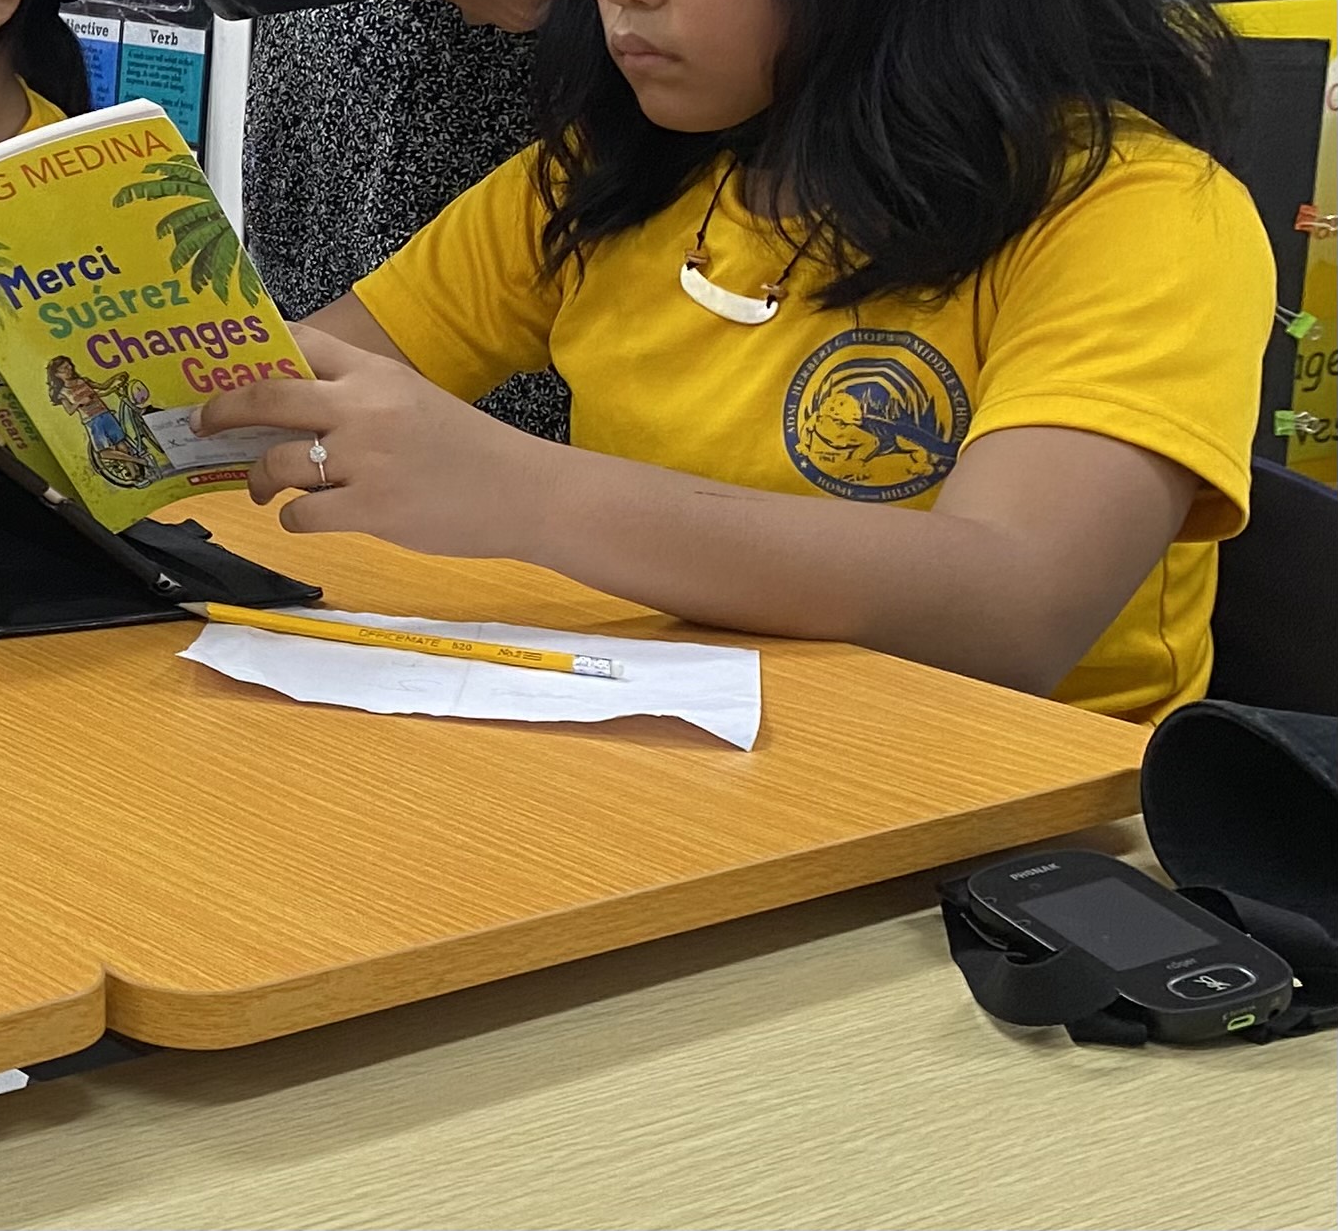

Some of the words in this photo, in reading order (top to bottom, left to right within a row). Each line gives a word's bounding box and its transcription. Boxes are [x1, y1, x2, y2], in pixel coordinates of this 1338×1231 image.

[149, 29, 179, 46] Verb
[20, 130, 172, 188] MEDINA
[39, 279, 190, 339] Suárez
[86, 315, 270, 370] Changes
[911, 339, 955, 386] MIDDLE
[181, 357, 304, 393] Gears
[358, 628, 441, 649] OFFICEMATE
[1009, 862, 1062, 882] PHONAK
